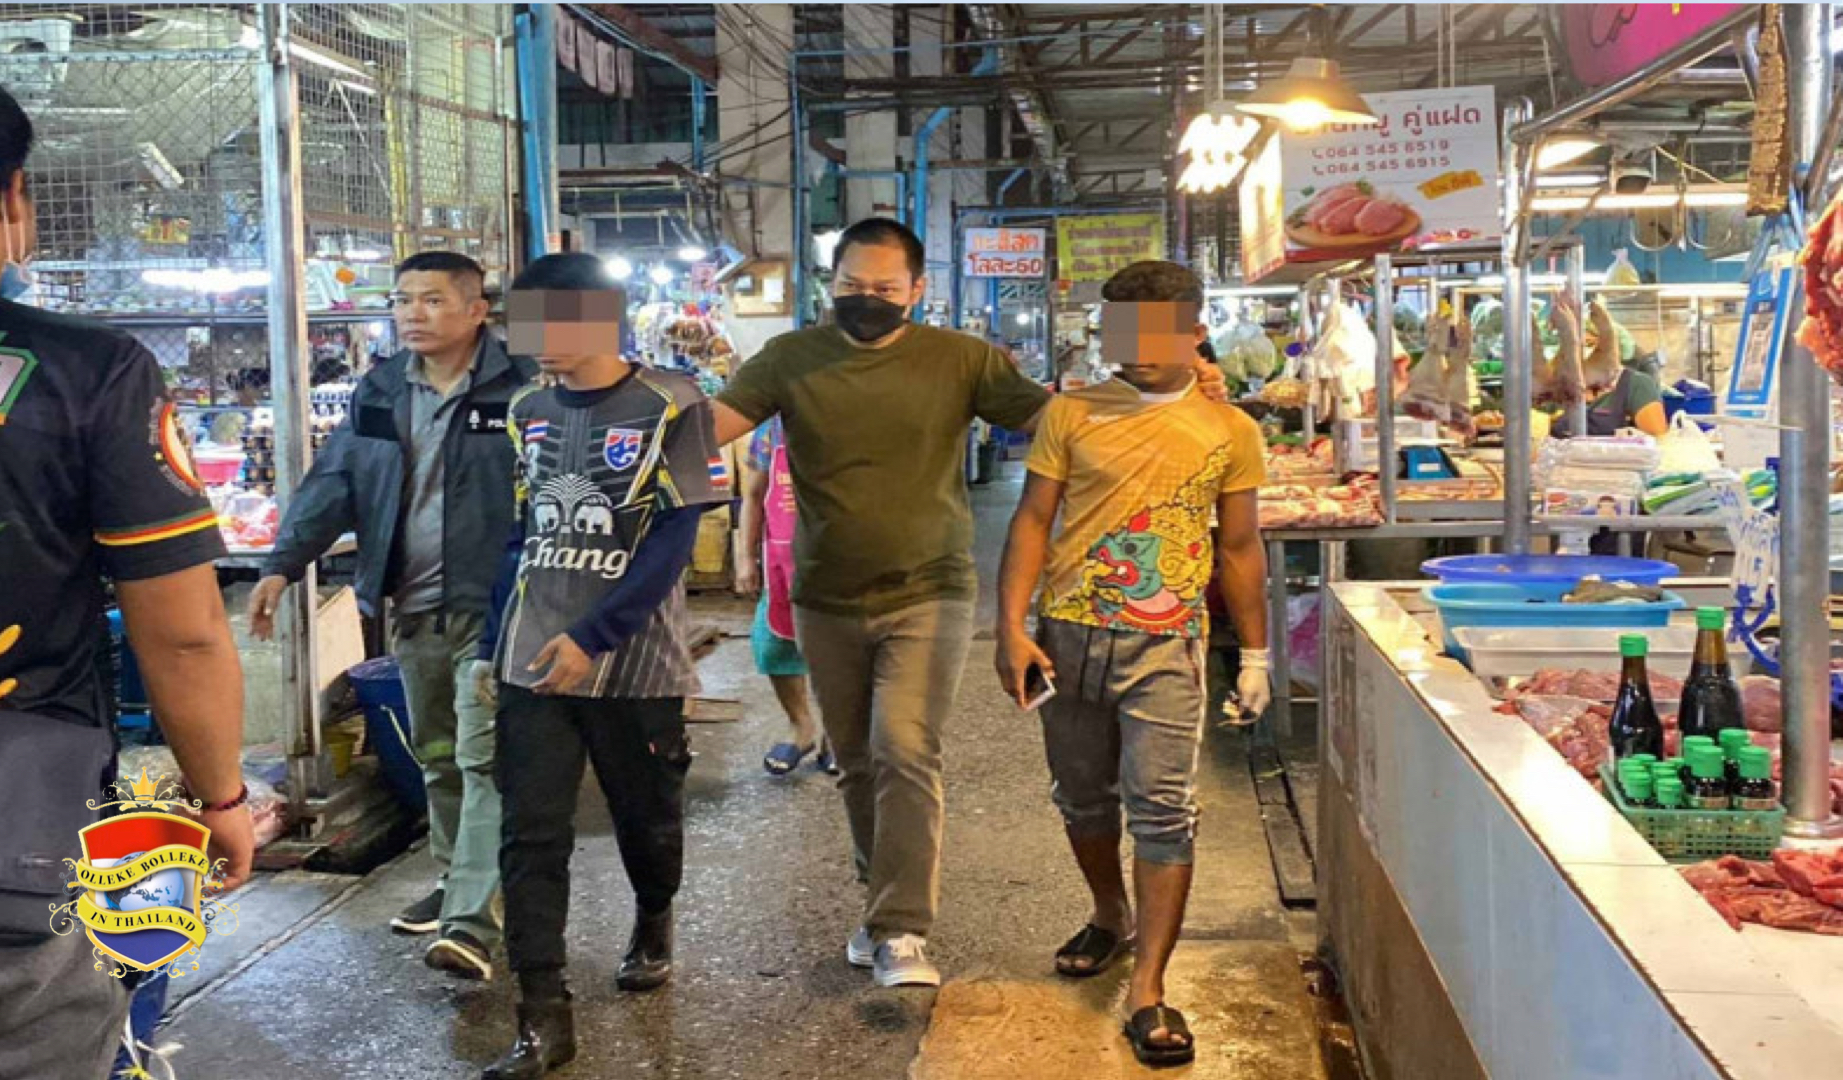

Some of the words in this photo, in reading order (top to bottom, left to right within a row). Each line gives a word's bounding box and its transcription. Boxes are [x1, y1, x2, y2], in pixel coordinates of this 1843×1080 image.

[1403, 103, 1480, 135] คู่แฝด
[1366, 142, 1398, 155] 545
[1366, 159, 1399, 171] 545
